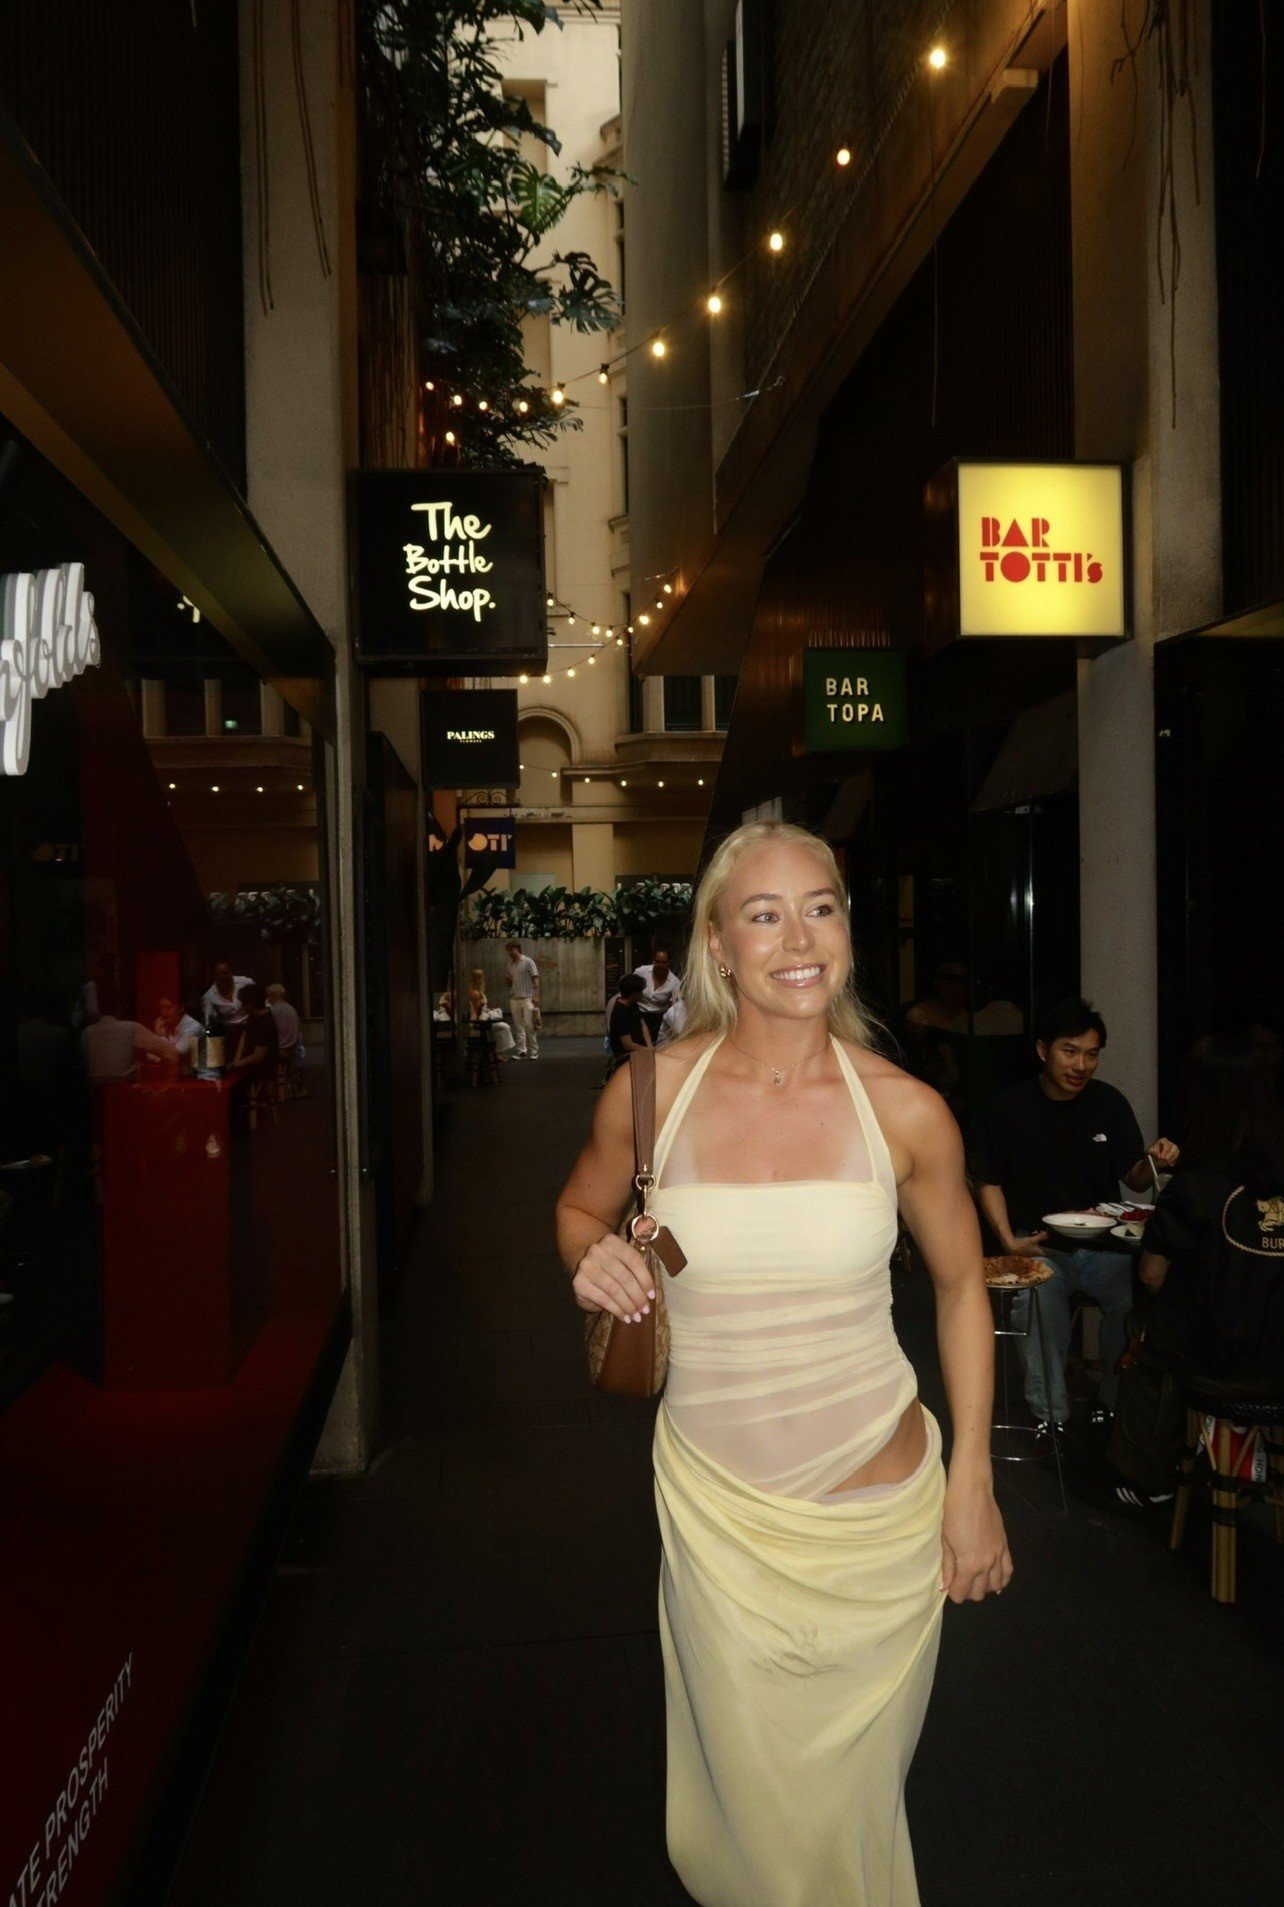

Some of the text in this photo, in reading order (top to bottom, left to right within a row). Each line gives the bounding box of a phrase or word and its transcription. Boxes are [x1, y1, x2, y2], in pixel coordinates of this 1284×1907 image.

[410, 501, 492, 541] The
[981, 516, 1050, 547] BAR
[402, 540, 494, 574] Bottle
[407, 575, 496, 622] Shop.
[826, 677, 869, 696] BAR
[826, 703, 884, 722] TOPA
[446, 730, 496, 740] PALINGS
[45, 1651, 133, 1860] PROSPERITY
